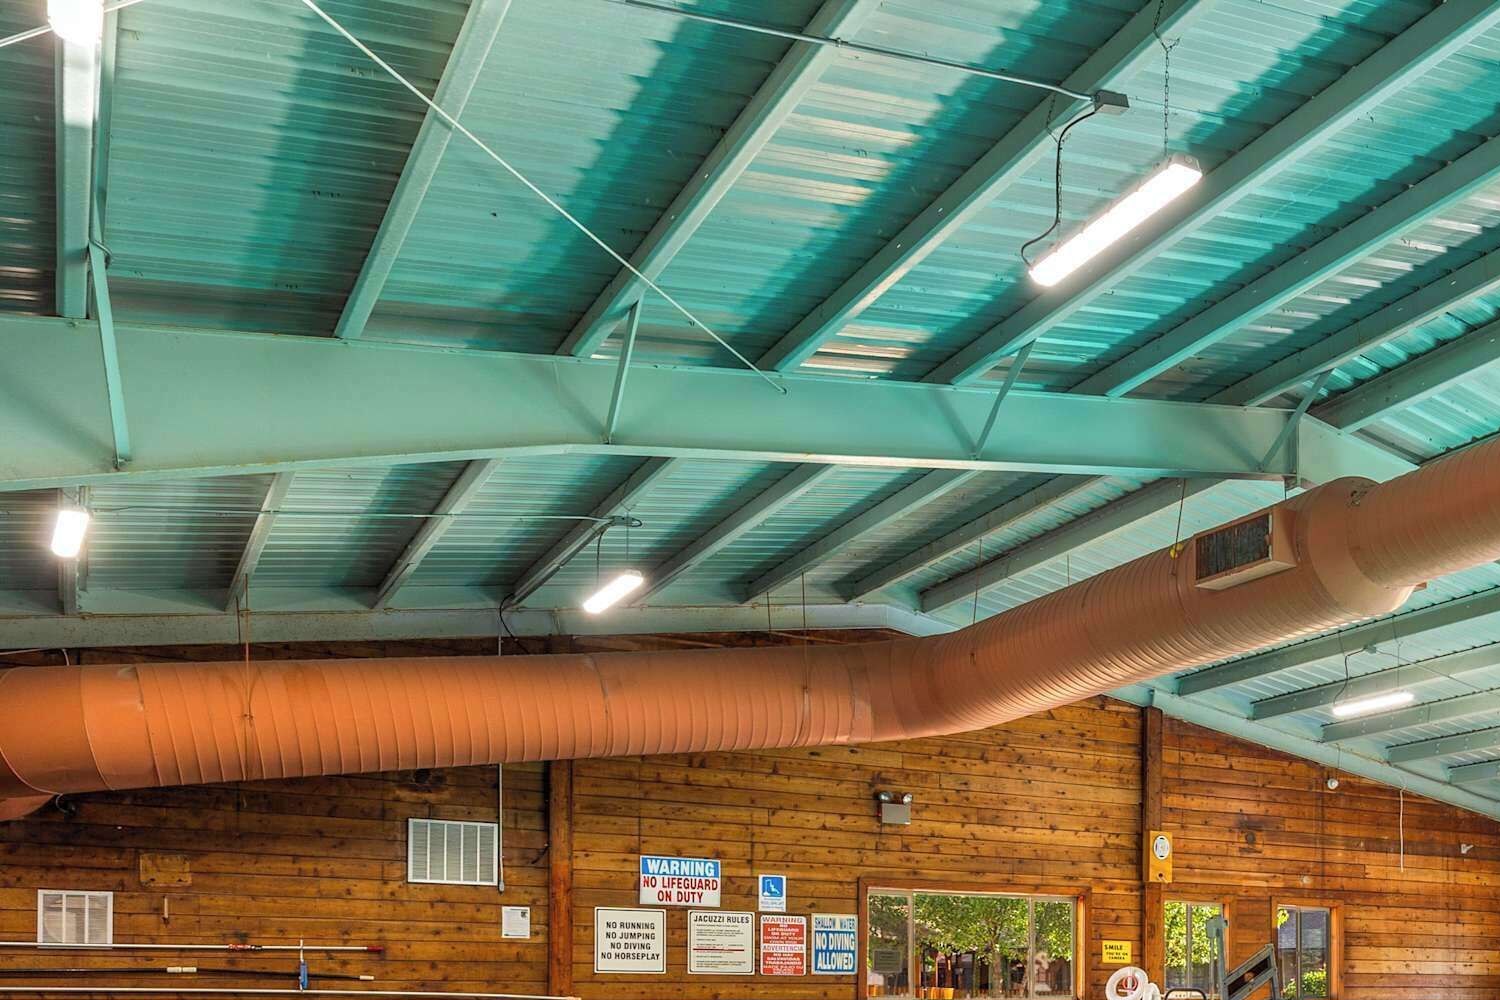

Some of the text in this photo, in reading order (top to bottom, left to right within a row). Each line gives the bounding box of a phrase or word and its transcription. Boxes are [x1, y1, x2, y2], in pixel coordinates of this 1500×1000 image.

[646, 858, 715, 877] WARNING
[643, 875, 718, 891] NO LIFEGUARD
[657, 890, 703, 903] ON DUTY
[693, 915, 750, 924] JACUZZI RULES
[815, 916, 856, 930] SHALLOW WATER
[606, 921, 655, 930] NO RUNNING
[605, 931, 656, 940] NO JUMPING
[610, 942, 651, 950] NO DIVING
[815, 932, 855, 951] NO DIVING
[763, 944, 804, 952] ADVERTENCIA
[601, 952, 660, 960] NO HORSEPLAY
[816, 951, 854, 970] ALLOWED
